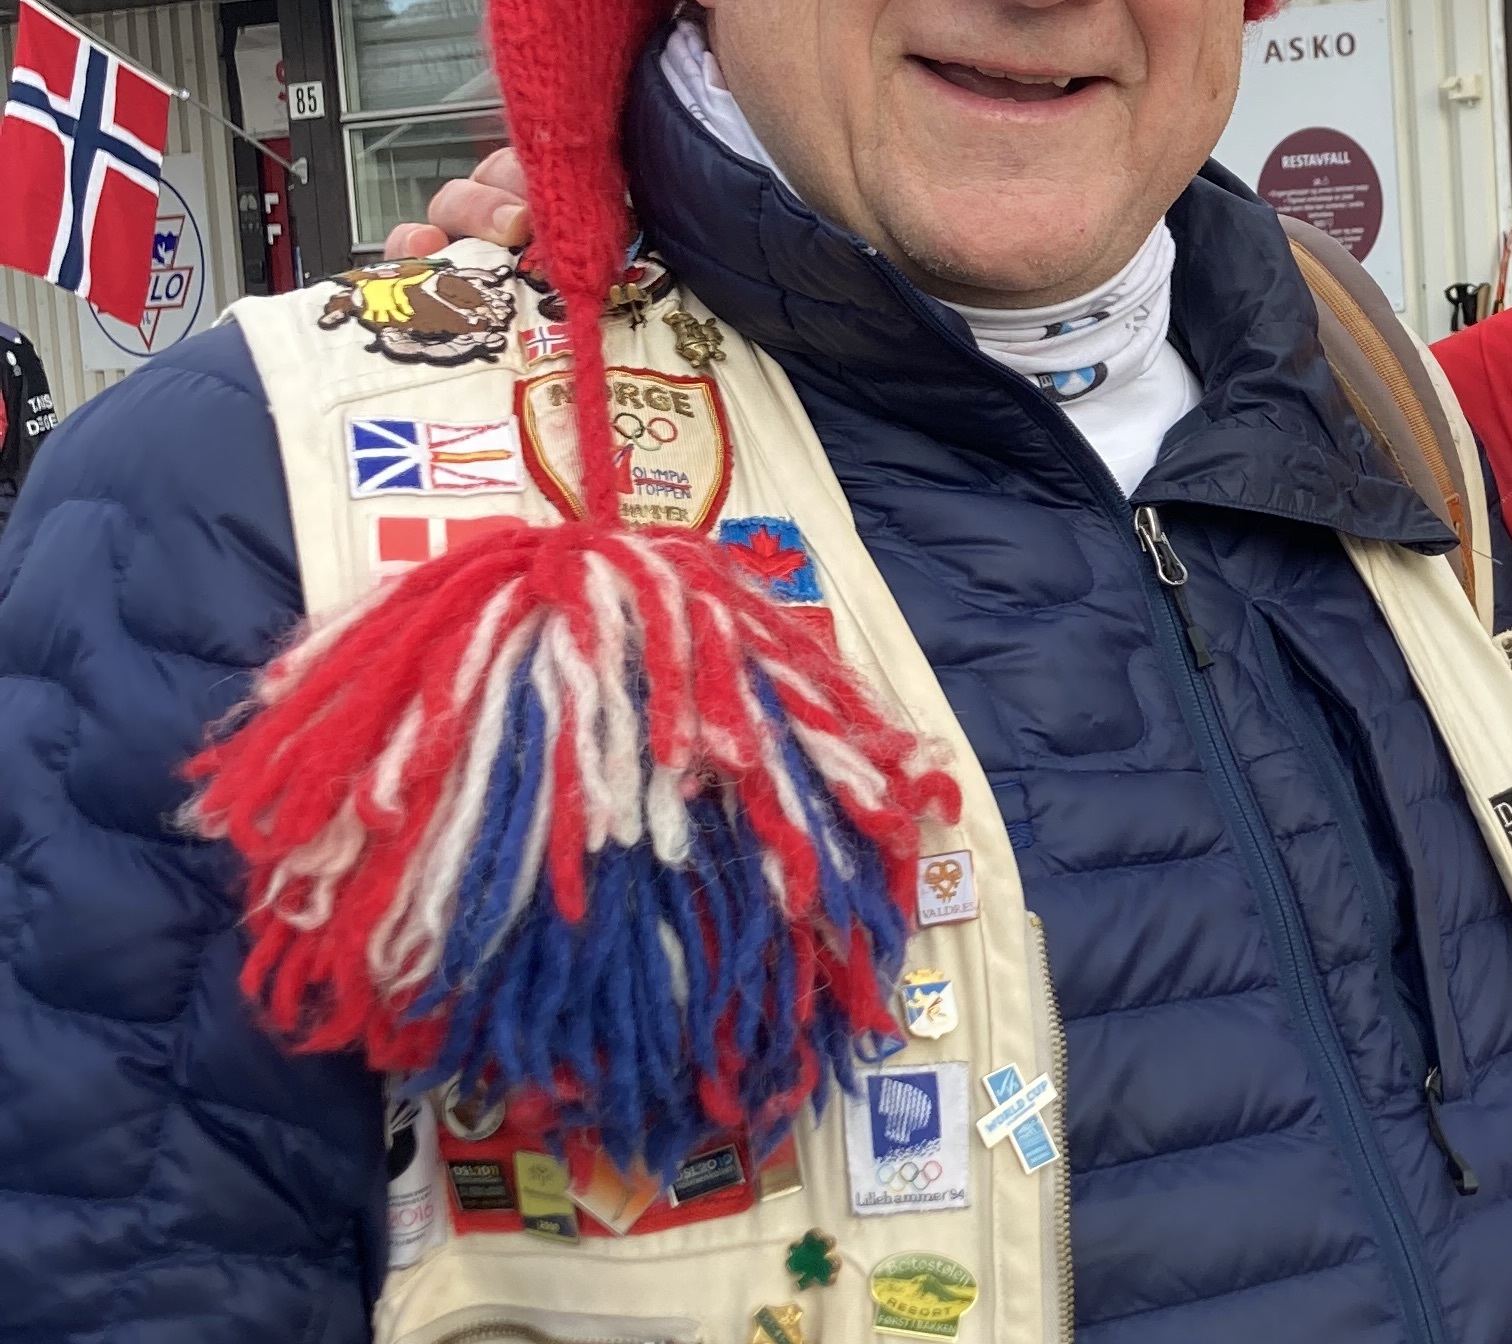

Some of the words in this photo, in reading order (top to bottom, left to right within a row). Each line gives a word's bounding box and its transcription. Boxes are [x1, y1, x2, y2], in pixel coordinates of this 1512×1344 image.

[1264, 32, 1357, 65] ASKO
[296, 84, 318, 113] 85
[1281, 151, 1351, 170] RESTAVFALL
[549, 381, 695, 418] NRGE
[632, 466, 690, 484] OLYMPIA
[636, 485, 692, 499] TOPPEN
[887, 1298, 952, 1317] RESORT
